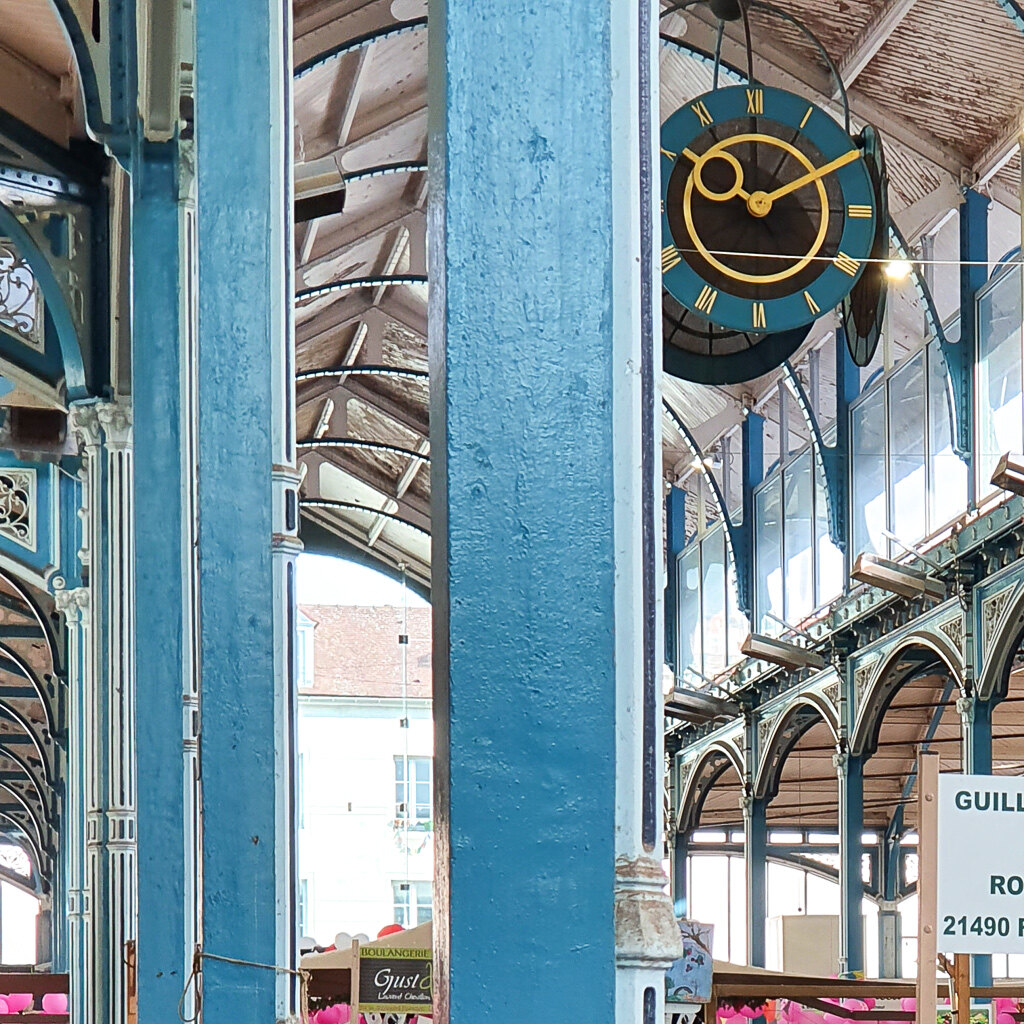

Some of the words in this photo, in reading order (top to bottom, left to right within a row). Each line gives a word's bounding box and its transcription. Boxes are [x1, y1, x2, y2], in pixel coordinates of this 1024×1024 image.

[746, 88, 763, 114] XII
[691, 100, 714, 128] XI
[848, 205, 872, 218] III
[943, 916, 1010, 937] 21490
[361, 948, 429, 957] BOULANGERIE
